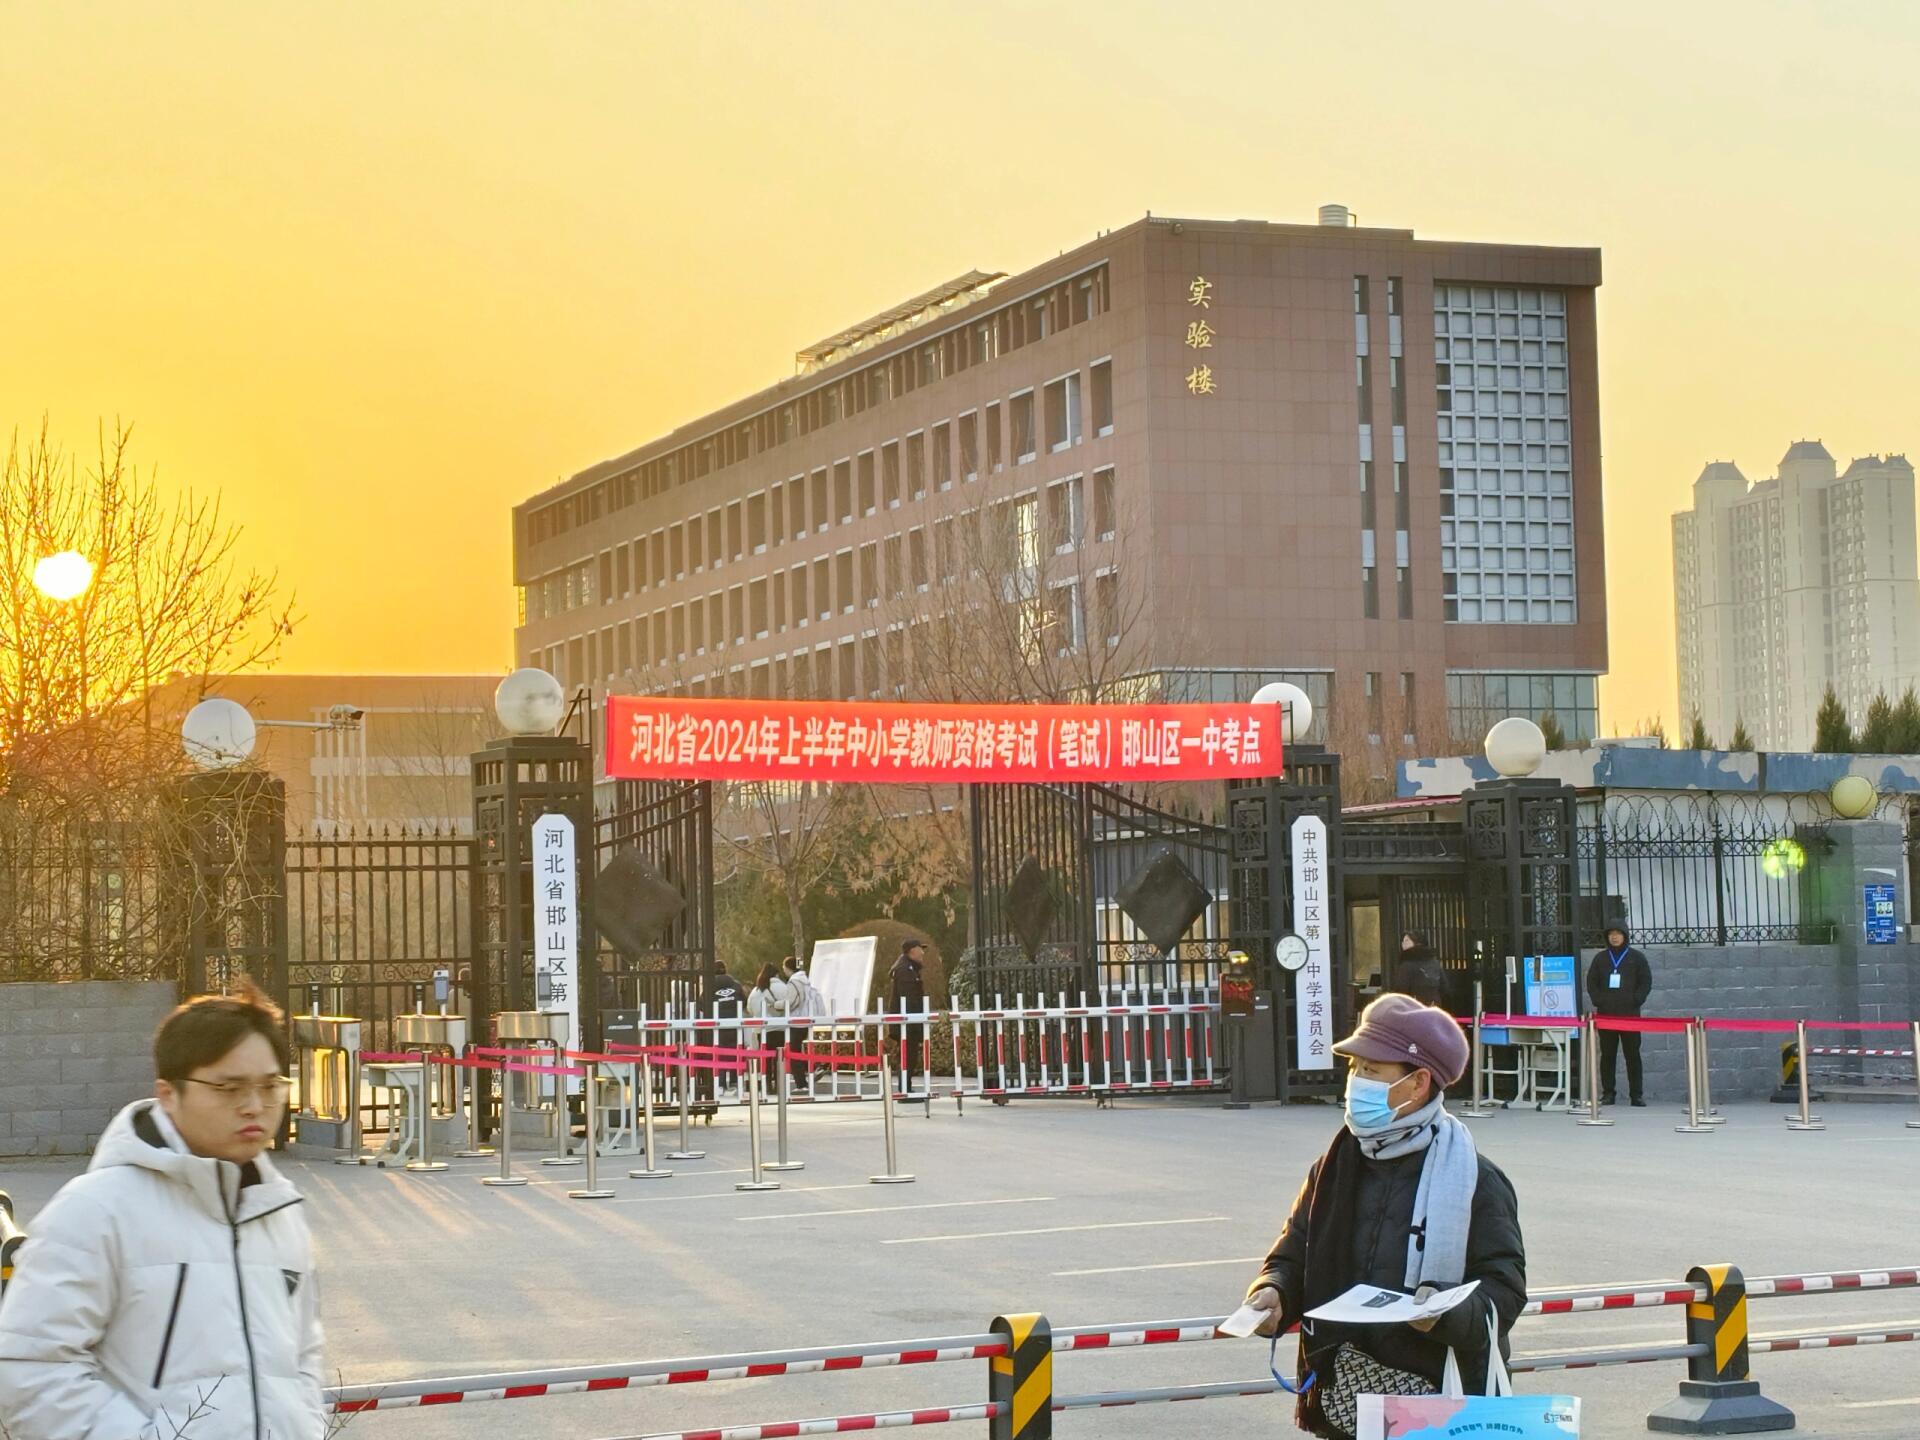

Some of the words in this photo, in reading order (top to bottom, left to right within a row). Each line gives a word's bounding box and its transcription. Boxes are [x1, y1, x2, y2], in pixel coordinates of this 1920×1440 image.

[1185, 276, 1217, 395] 实验楼
[1302, 828, 1324, 1056] 中共邯山区第一中学委员会
